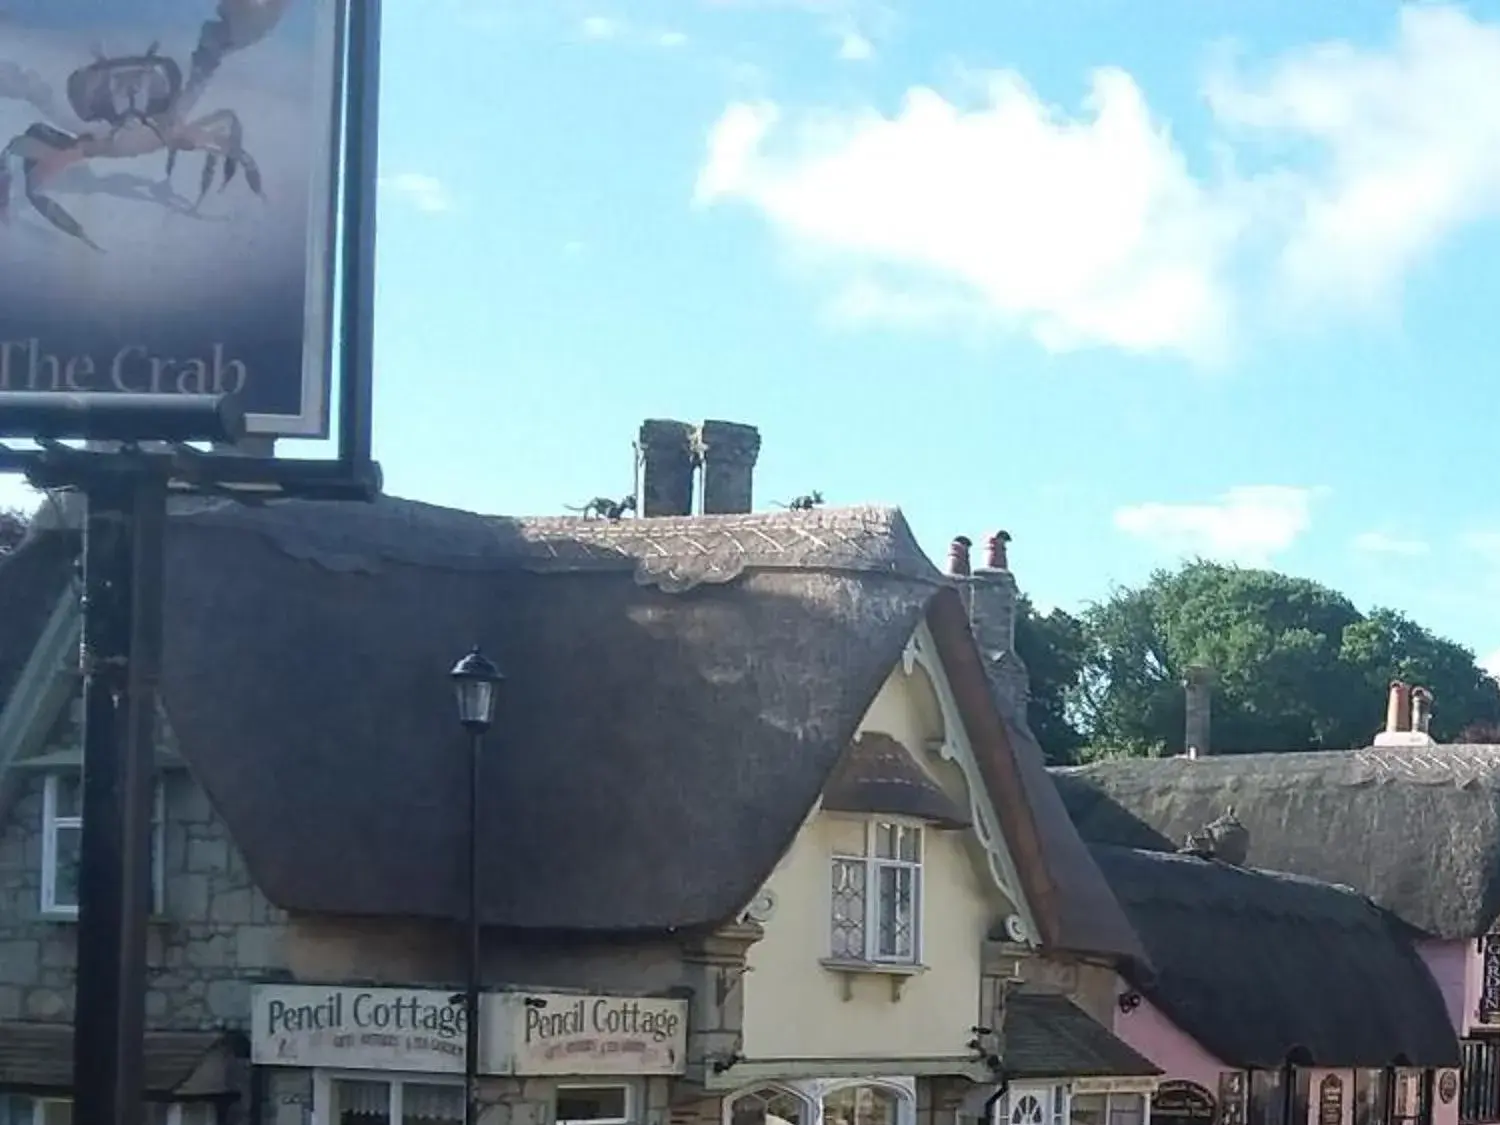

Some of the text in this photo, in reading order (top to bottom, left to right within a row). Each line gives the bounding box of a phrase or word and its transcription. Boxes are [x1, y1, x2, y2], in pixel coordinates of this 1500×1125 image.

[0, 337, 247, 394] The Crab
[269, 992, 468, 1038] Pencil Cottage
[525, 999, 680, 1043] Pencil Cottage
